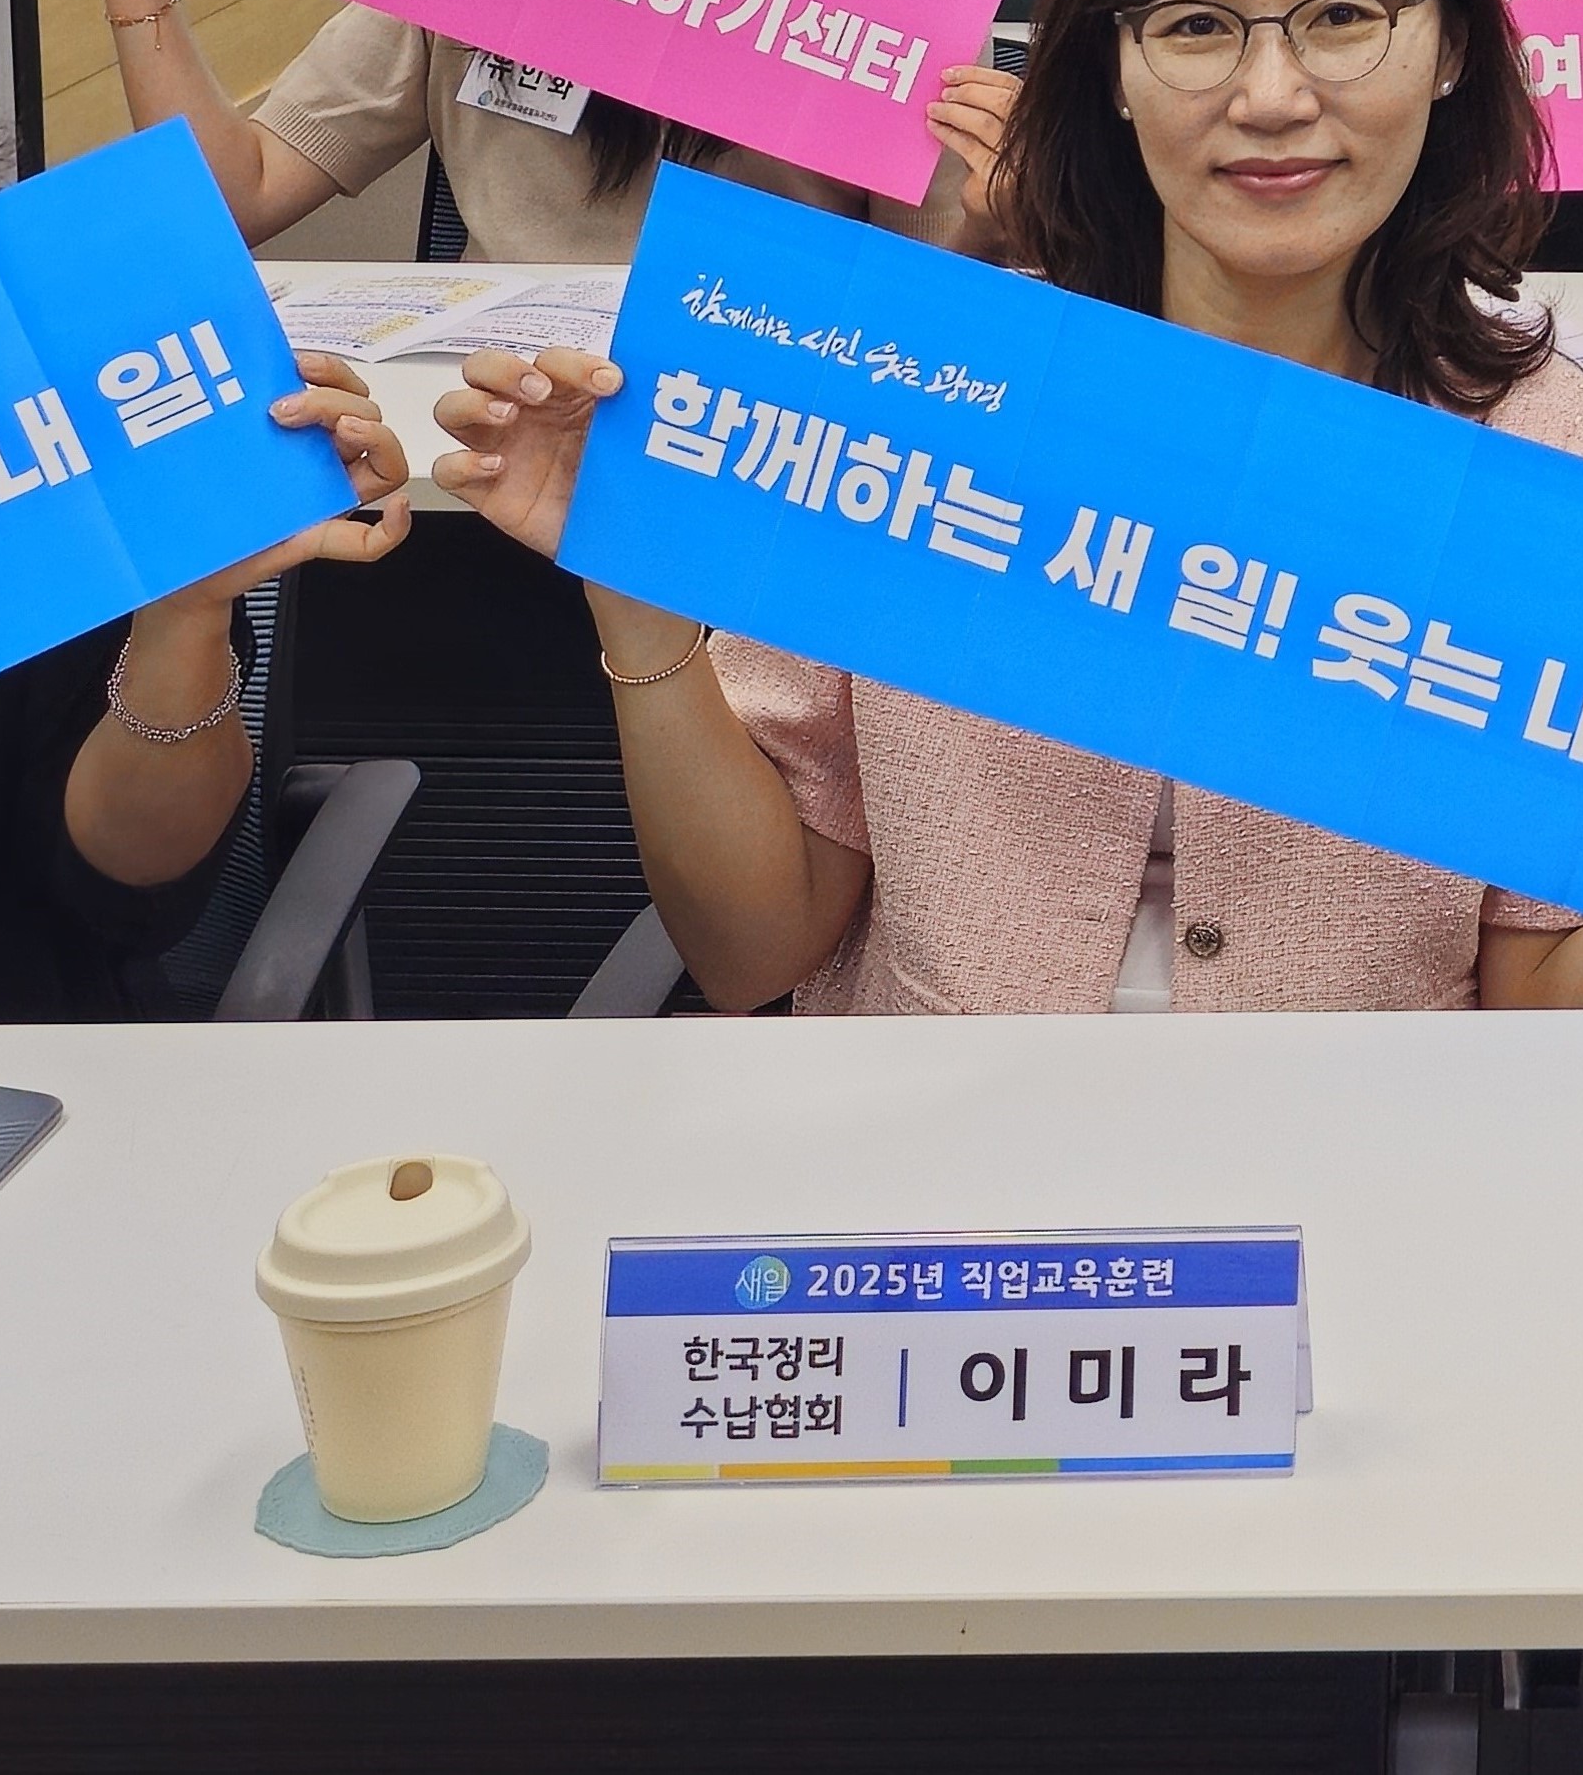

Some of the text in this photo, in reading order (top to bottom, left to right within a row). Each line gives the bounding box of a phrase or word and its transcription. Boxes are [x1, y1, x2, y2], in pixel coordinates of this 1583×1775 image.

[682, 274, 1006, 412] 함께하는 시민 웃는 광명
[98, 320, 244, 448] 일!
[645, 369, 1023, 572] 함께하는
[1043, 506, 1153, 613] 새
[1168, 544, 1298, 658] 일!
[1312, 593, 1502, 729] 웃는
[808, 1263, 943, 1300] 2025년
[962, 1257, 1173, 1299] 직업교육훈련
[684, 1336, 843, 1381] 한국정리
[960, 1345, 1251, 1421] 이미라
[681, 1393, 842, 1439] 수납협회
